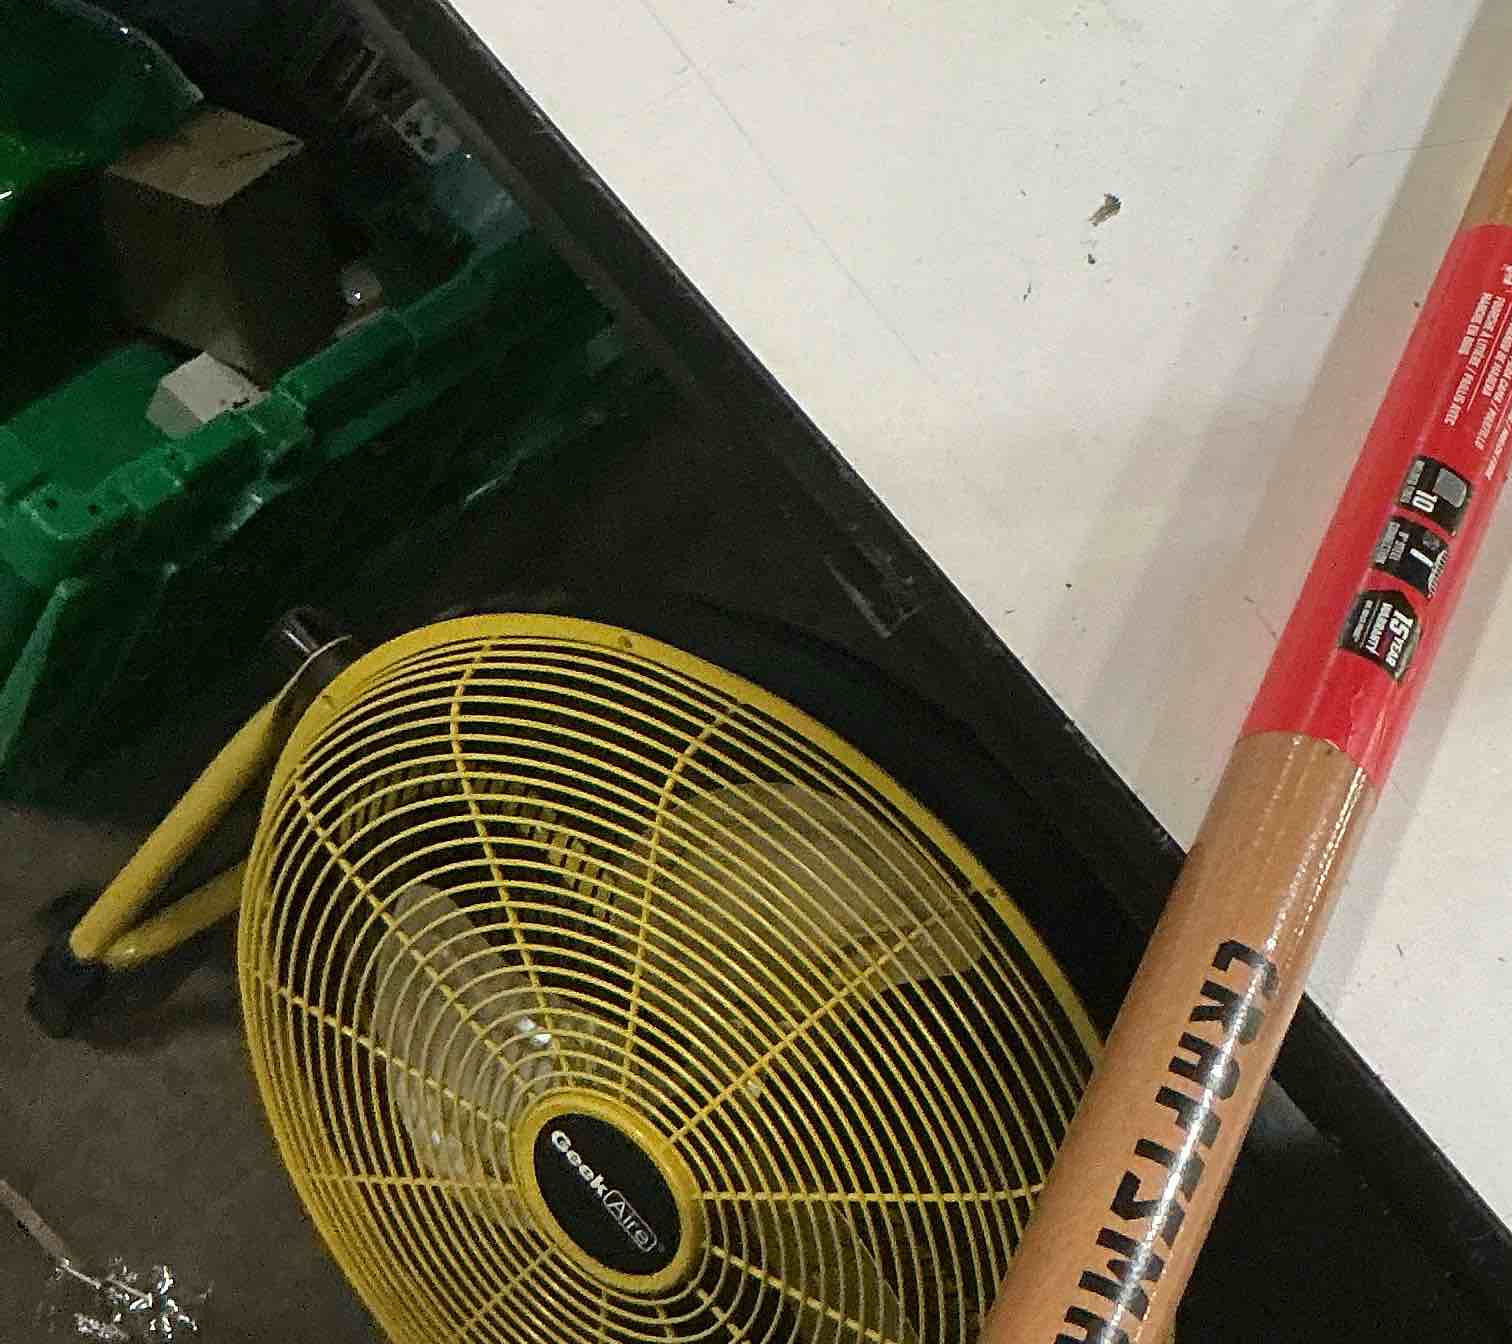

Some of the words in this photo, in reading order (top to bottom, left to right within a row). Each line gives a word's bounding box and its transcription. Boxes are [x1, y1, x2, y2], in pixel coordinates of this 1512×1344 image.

[1412, 490, 1438, 513] 10
[1389, 611, 1414, 637] 15
[1386, 634, 1406, 667] YEAR
